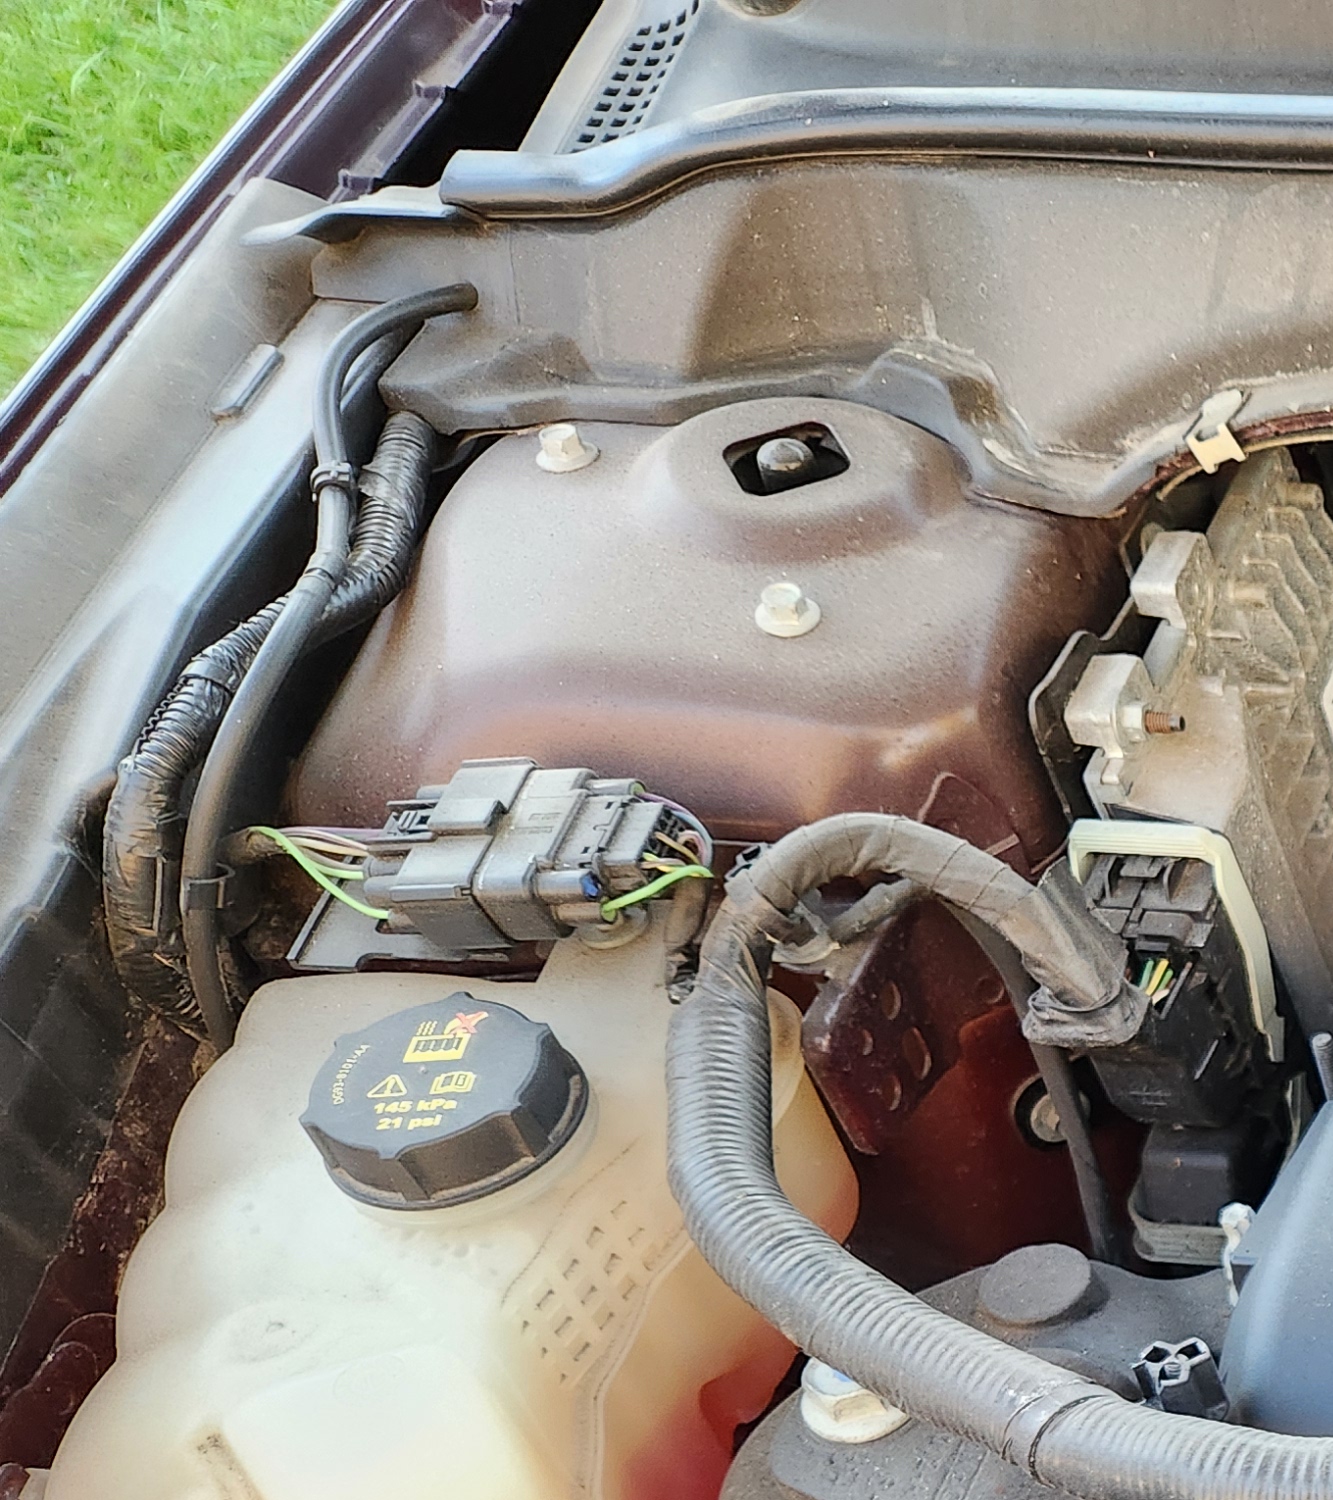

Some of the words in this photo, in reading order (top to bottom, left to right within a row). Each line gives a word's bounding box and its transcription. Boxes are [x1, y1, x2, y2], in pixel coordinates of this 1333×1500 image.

[373, 1100, 412, 1114] 145
[416, 1098, 457, 1112] kPa
[375, 1116, 401, 1131] 21
[407, 1114, 442, 1130] psi
